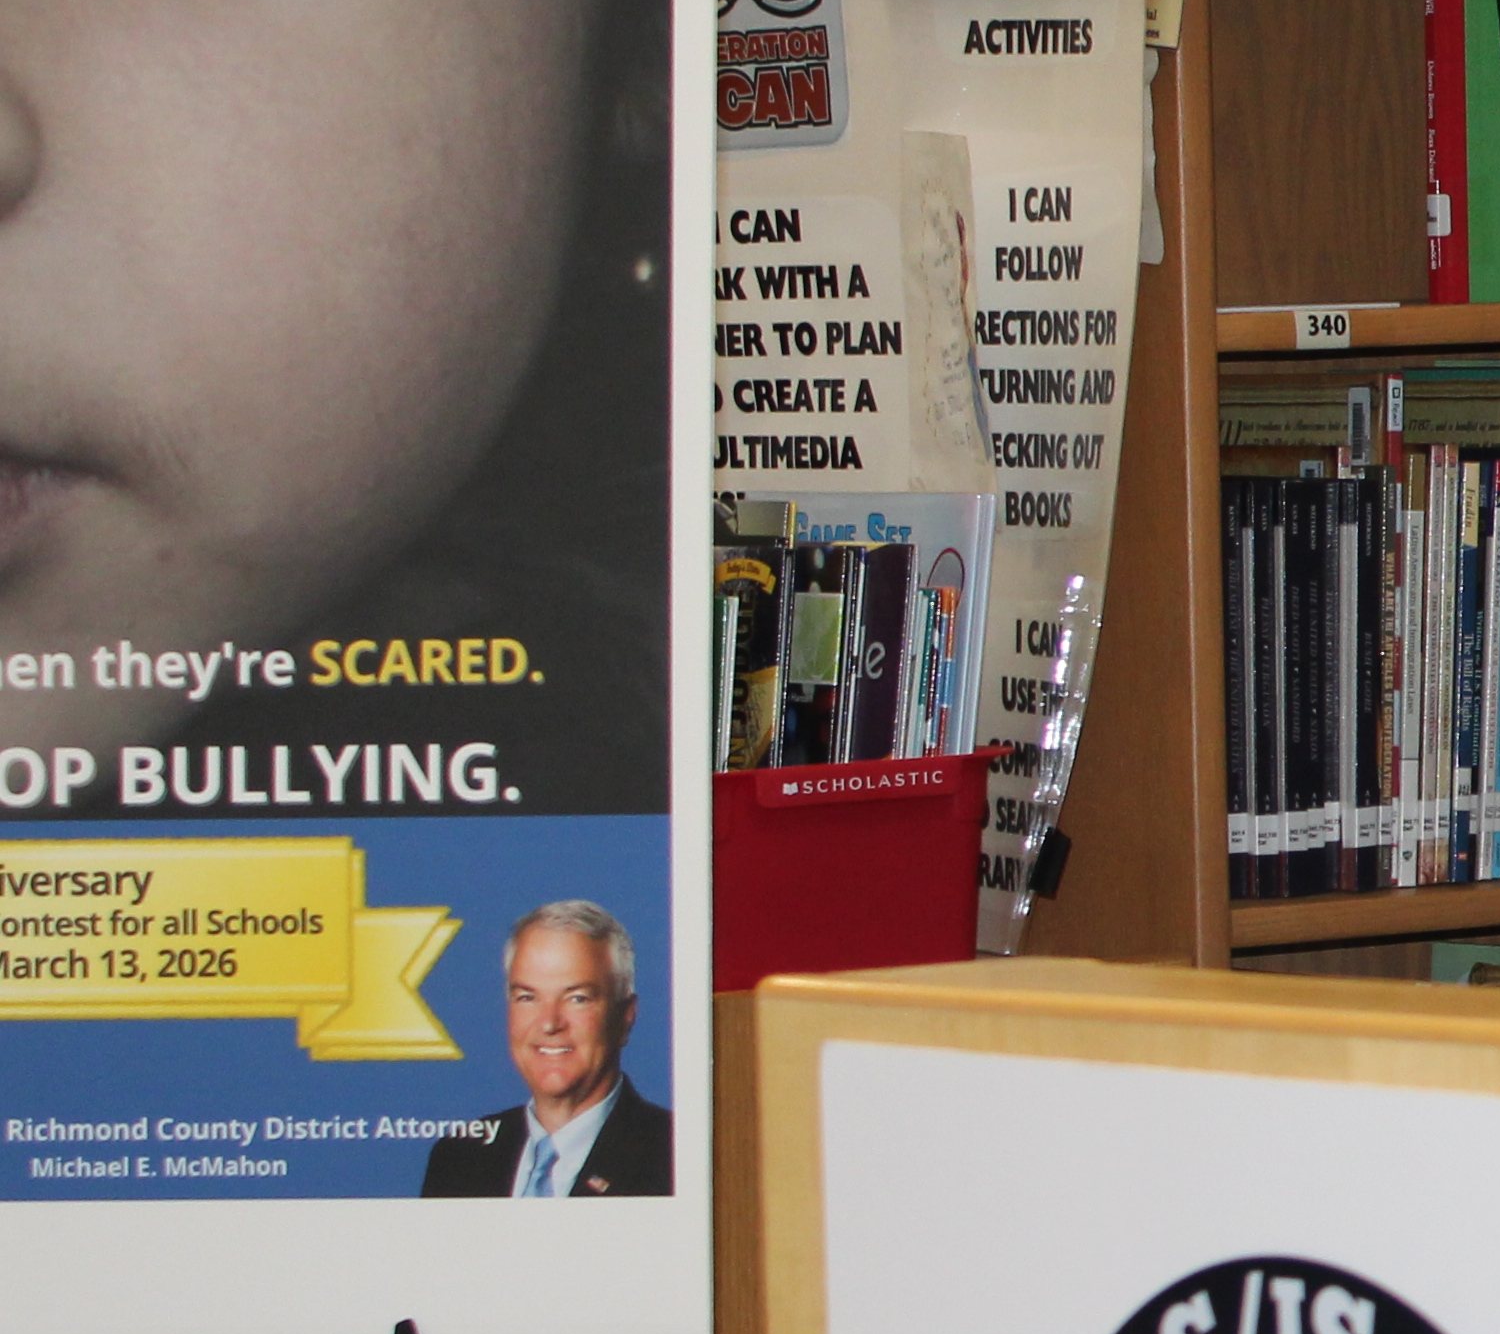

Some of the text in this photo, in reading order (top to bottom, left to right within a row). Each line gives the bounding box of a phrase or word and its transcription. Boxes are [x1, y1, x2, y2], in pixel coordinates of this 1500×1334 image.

[964, 19, 1093, 56] ACTIVITIES
[717, 63, 833, 129] CAN
[1023, 187, 1072, 223] CAN
[730, 209, 802, 244] CAN
[995, 246, 1084, 281] FOLLOW
[757, 264, 870, 300] WITH A
[772, 320, 902, 357] TO PLAN
[1307, 314, 1347, 337] 340
[736, 377, 878, 413] CREATE A
[1005, 491, 1072, 527] BOOKS
[92, 637, 546, 701] they're SCARED.
[120, 741, 523, 806] BULLYING.
[802, 770, 945, 796] SCHOLASTIC
[109, 907, 323, 938] for all Schools
[100, 948, 238, 984] 13, 2026
[7, 1114, 501, 1146] Richmond County District Attorney
[31, 1155, 288, 1178] Michael E. McMahon
